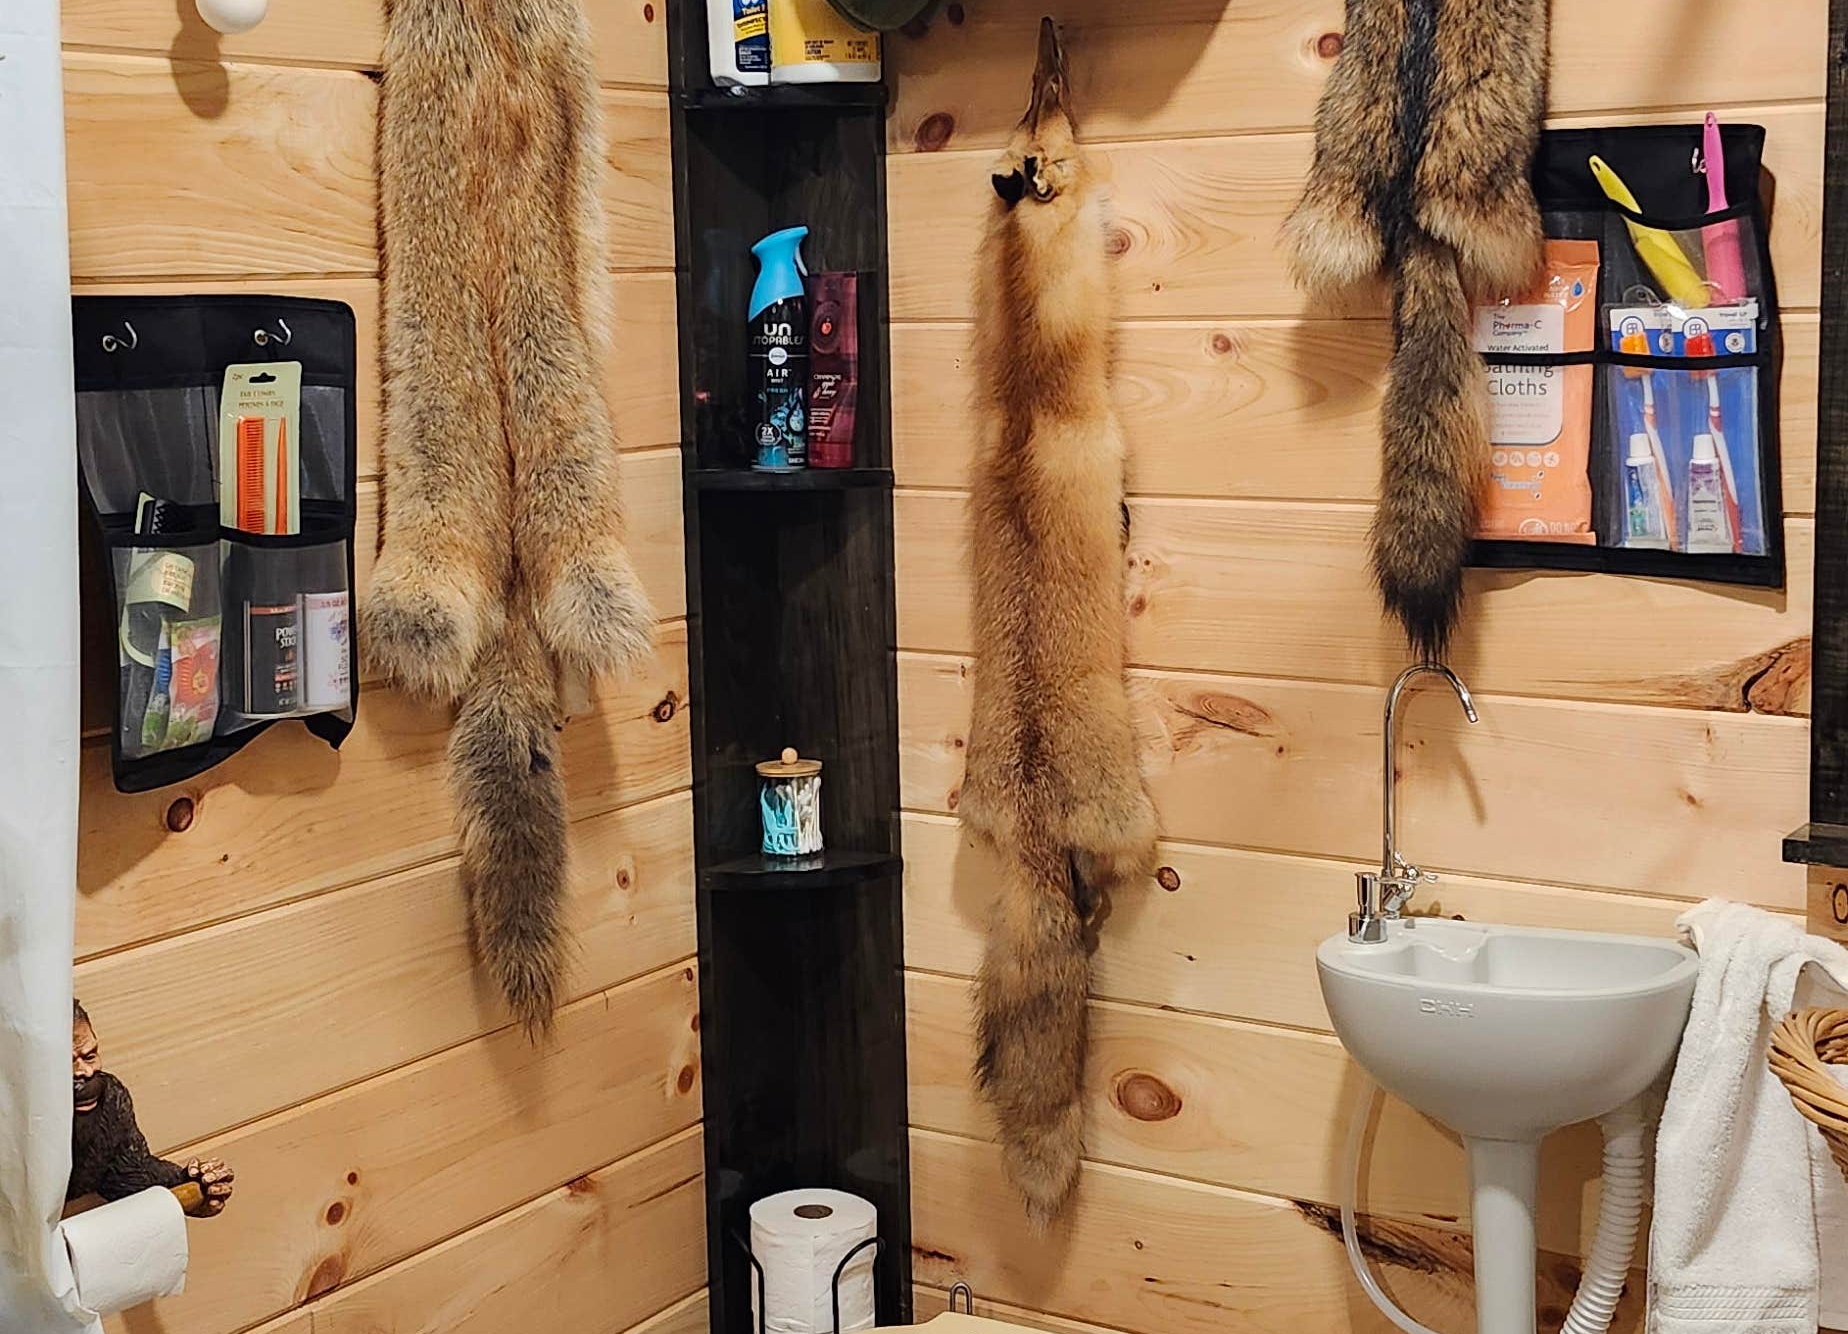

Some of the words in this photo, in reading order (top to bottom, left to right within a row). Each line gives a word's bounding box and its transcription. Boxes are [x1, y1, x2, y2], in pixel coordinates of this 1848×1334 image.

[1493, 319, 1543, 330] Pharma-C
[1487, 345, 1511, 353] Water
[1512, 344, 1549, 352] Activated
[766, 368, 789, 378] AIR
[1484, 364, 1554, 378] athing
[1487, 378, 1548, 396] Cloths
[761, 426, 774, 436] 2X
